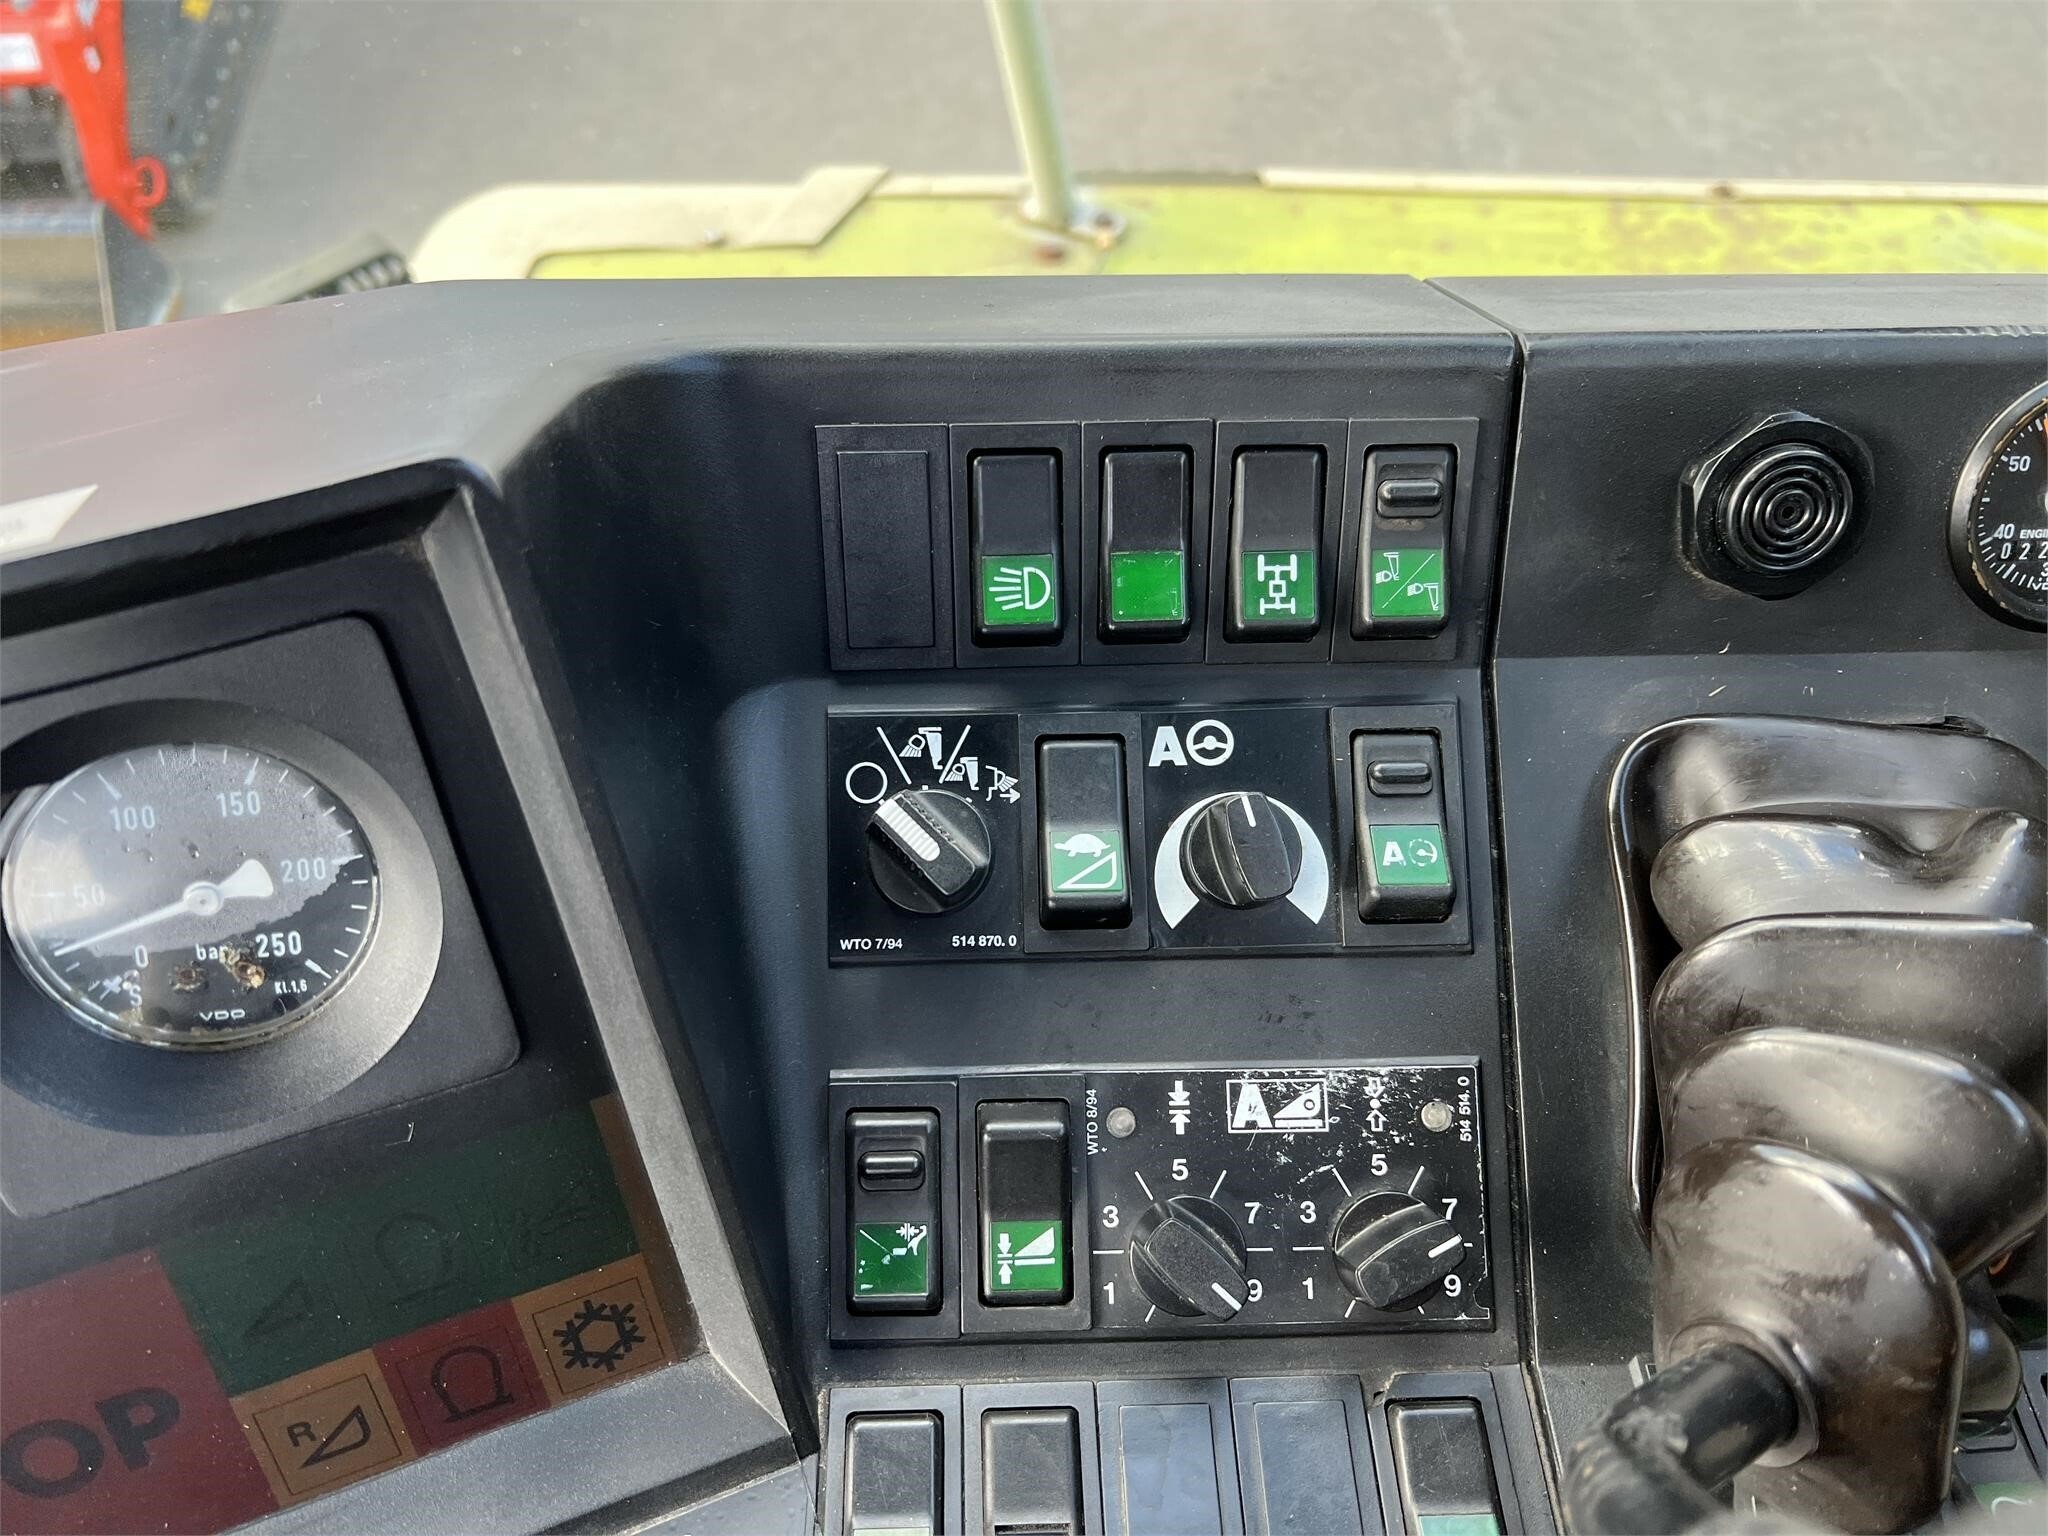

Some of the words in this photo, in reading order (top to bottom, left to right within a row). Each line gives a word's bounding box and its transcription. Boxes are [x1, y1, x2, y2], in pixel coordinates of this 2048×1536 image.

[2009, 455, 2031, 472] 50
[1993, 524, 2015, 540] 40
[2020, 528, 2048, 539] ENGI
[1148, 725, 1188, 767] A
[216, 790, 262, 817] 150
[110, 806, 156, 831] 100
[1382, 841, 1406, 866] A
[281, 857, 327, 883] 200
[73, 884, 105, 907] 50
[195, 943, 229, 963] bar
[255, 931, 302, 958] 250
[840, 938, 872, 950] WTO
[875, 938, 903, 950] 7/94
[951, 935, 976, 947] 514
[135, 944, 149, 968] 0
[200, 1008, 246, 1022] VDO
[1086, 1089, 1098, 1119] 8/94
[1232, 1083, 1273, 1129] A
[1087, 1121, 1099, 1156] WTO
[1459, 1125, 1472, 1142] 514
[1171, 1158, 1189, 1181] 5
[1370, 1153, 1389, 1177] 5
[1102, 1205, 1120, 1228] 3
[1244, 1202, 1261, 1224] 7
[1300, 1201, 1317, 1224] 3
[1441, 1198, 1458, 1221] 7
[1103, 1281, 1115, 1305] 1
[1247, 1278, 1263, 1302] 9
[1302, 1276, 1314, 1300] 1
[1443, 1274, 1462, 1298] 9
[286, 1421, 318, 1448] R
